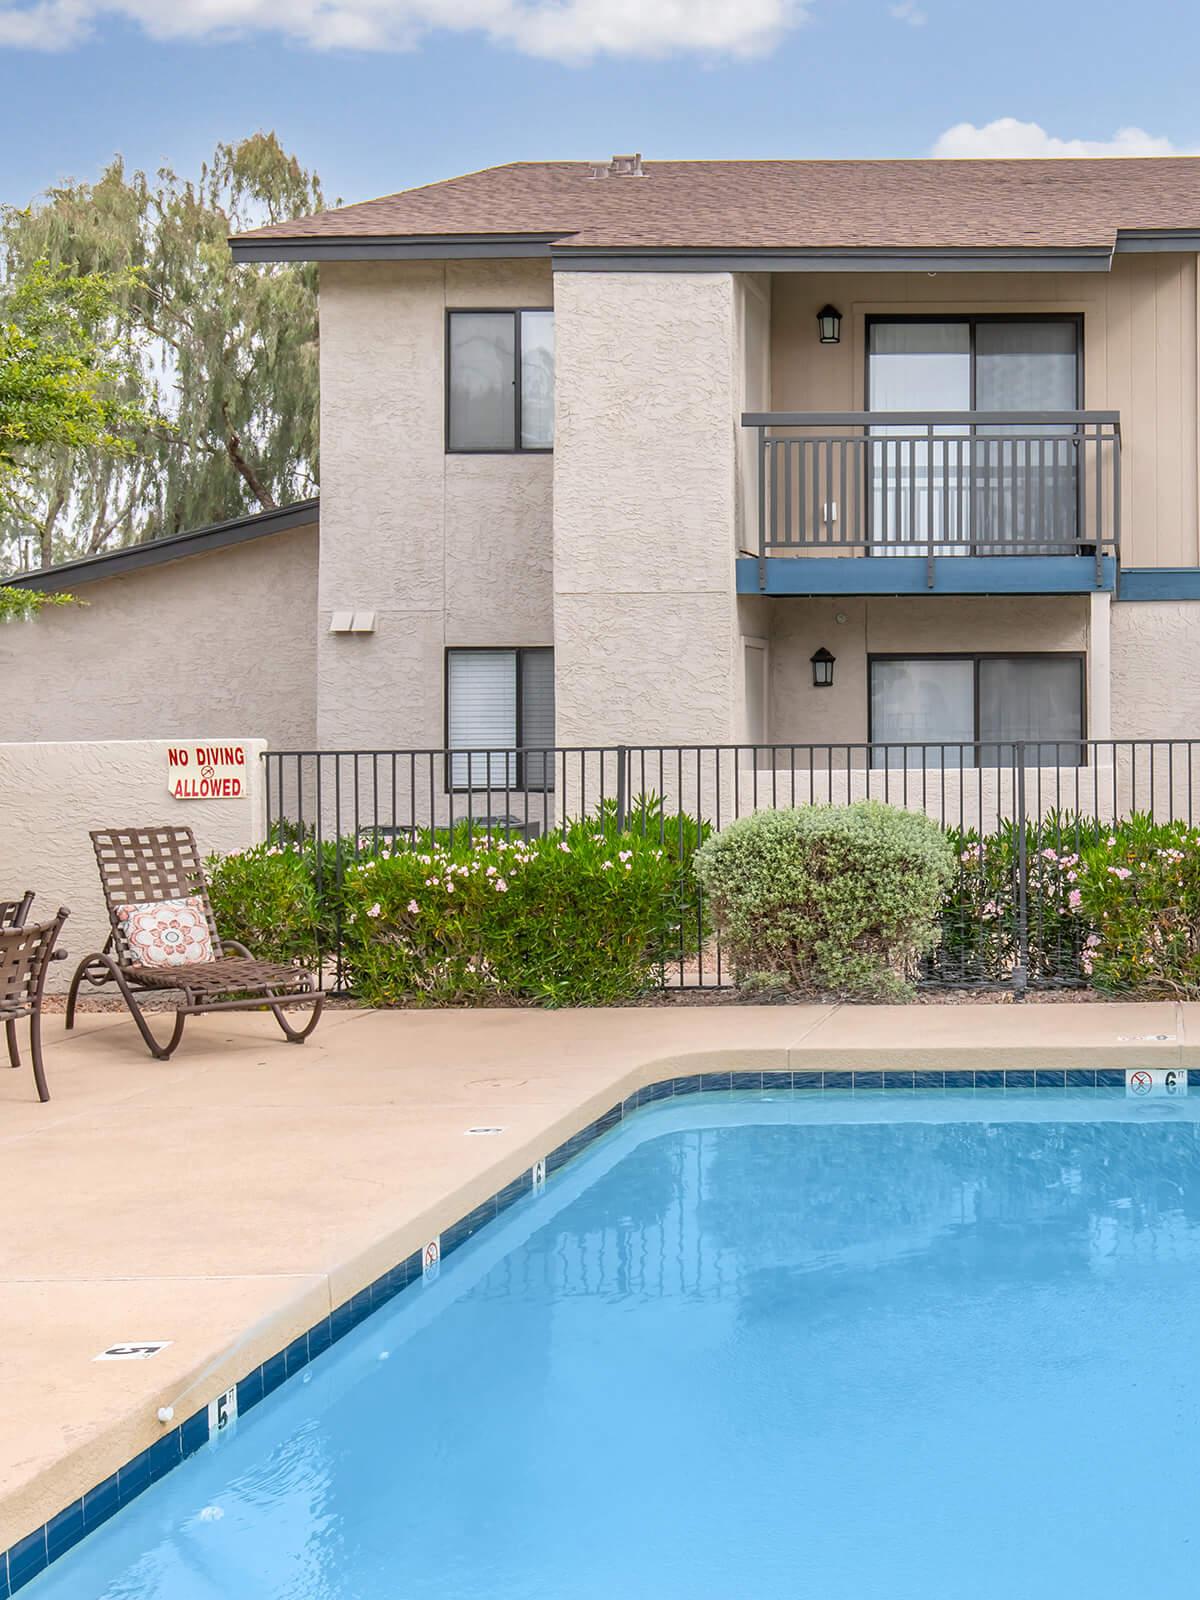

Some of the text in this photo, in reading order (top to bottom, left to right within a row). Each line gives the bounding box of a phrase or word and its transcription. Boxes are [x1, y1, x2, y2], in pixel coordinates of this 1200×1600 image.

[168, 747, 245, 766] NO DIVING
[175, 778, 241, 797] ALLOWED
[217, 1393, 228, 1430] 5
